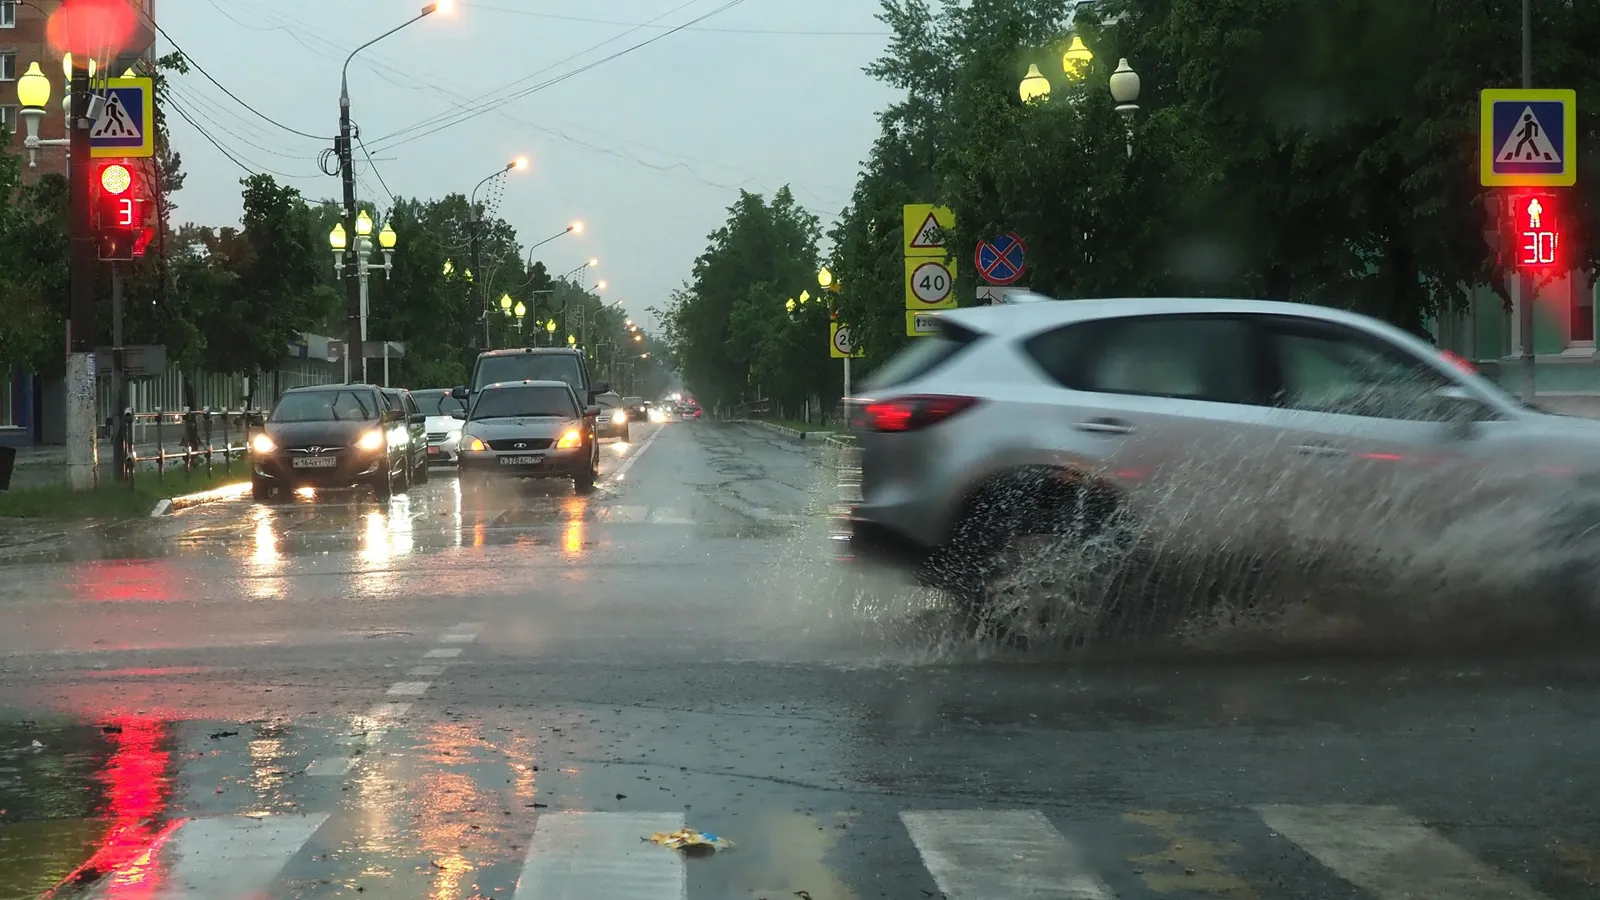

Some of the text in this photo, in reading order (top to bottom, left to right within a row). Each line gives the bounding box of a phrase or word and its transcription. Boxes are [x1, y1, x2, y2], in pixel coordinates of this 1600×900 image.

[119, 198, 132, 225] 3
[1523, 231, 1554, 264] 30
[919, 275, 945, 291] 40
